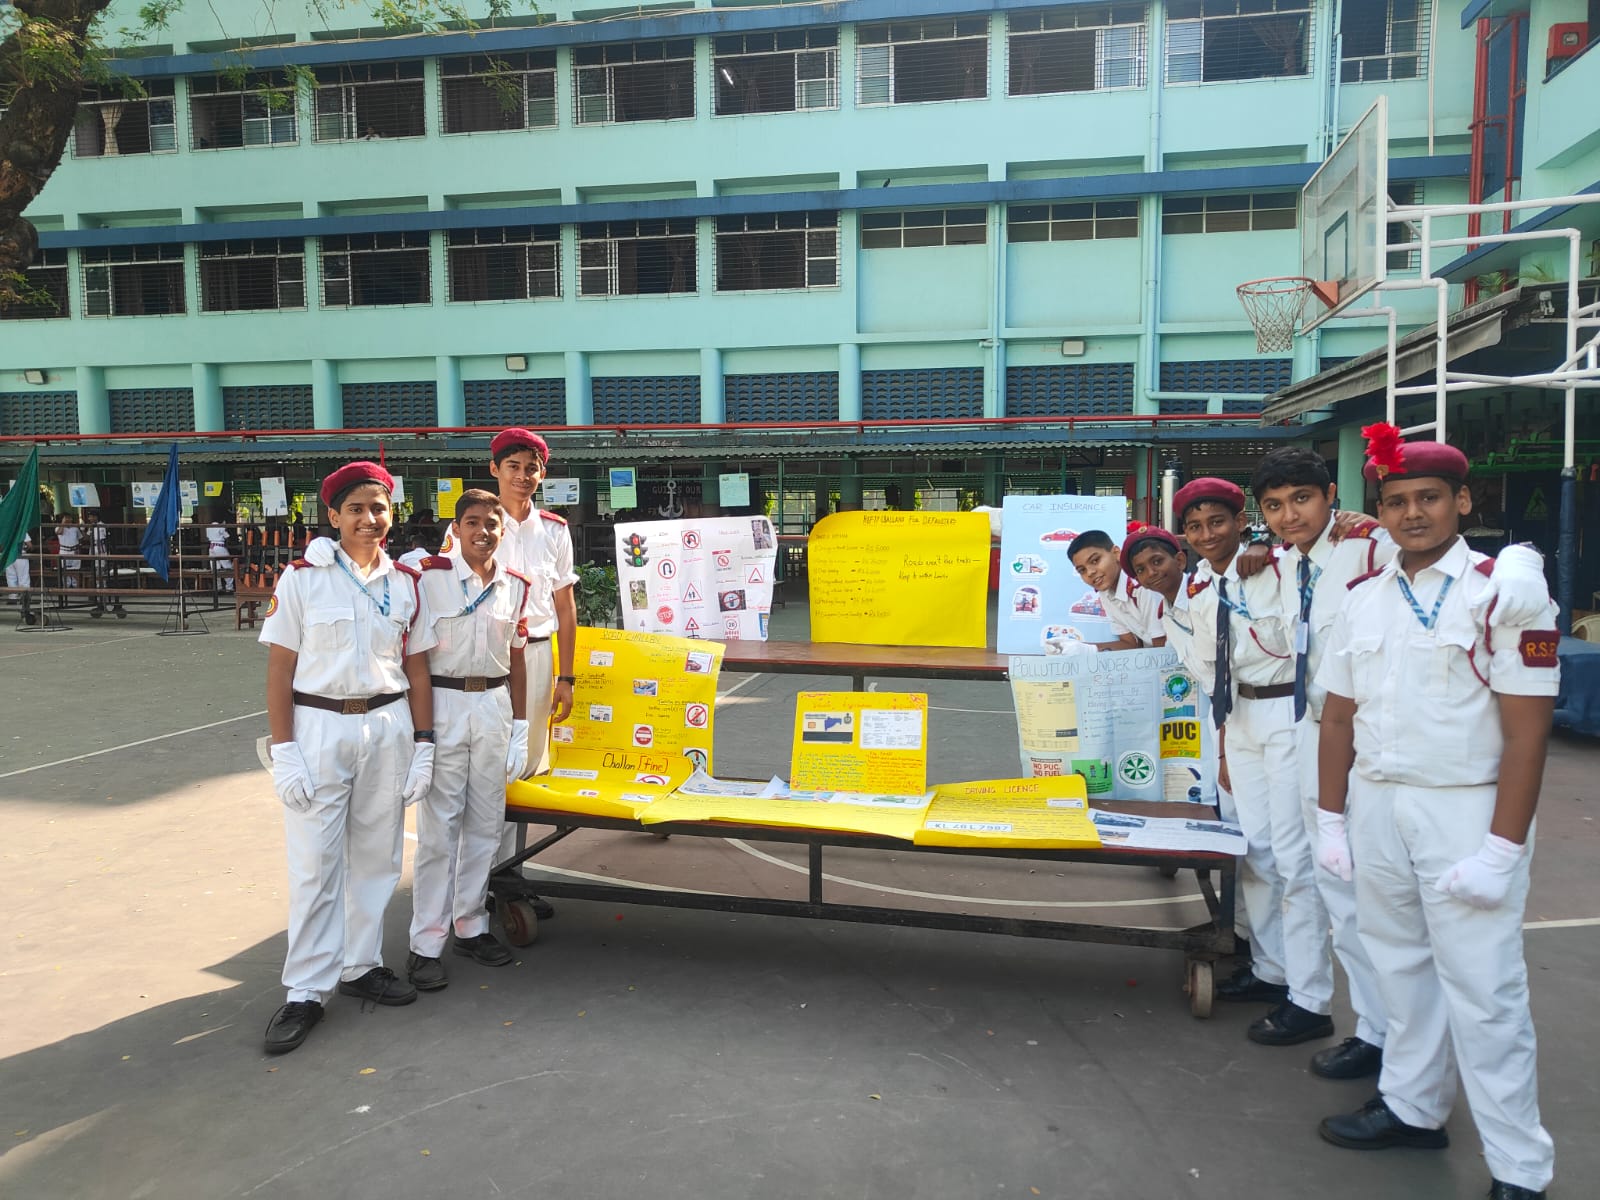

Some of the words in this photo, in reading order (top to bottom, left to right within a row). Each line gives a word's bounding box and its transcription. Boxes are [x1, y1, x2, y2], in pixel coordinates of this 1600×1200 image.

[652, 485, 682, 495] GUIS
[1022, 503, 1043, 512] CAR
[1048, 502, 1107, 512] INSURANCE
[1087, 649, 1129, 674] UNDER
[1135, 653, 1183, 670] CONTRO
[1162, 722, 1197, 742] PUC
[602, 752, 635, 771] Challan
